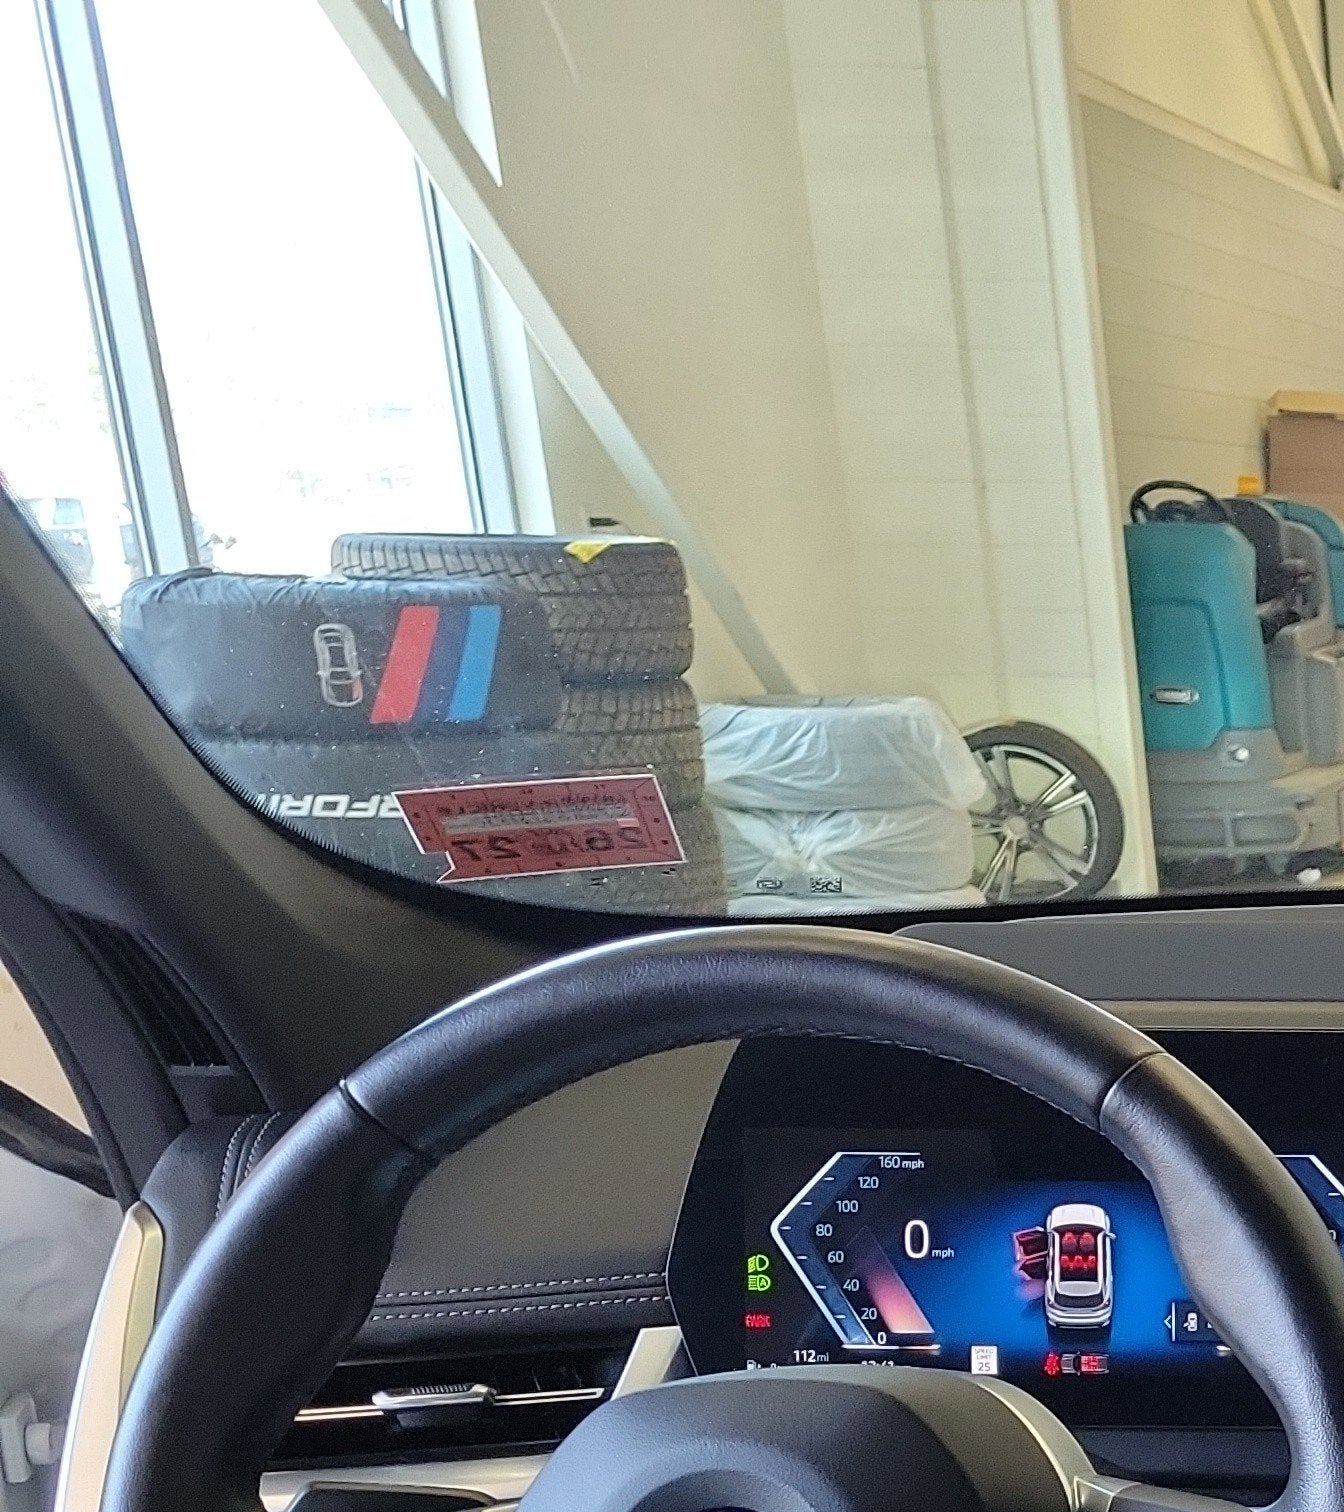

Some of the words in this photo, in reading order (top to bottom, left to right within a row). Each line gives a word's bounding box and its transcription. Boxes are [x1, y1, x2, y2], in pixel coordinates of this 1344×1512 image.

[878, 1156, 900, 1169] 160
[902, 1158, 924, 1170] mph
[858, 1176, 879, 1189] 120
[836, 1201, 858, 1213] 100
[815, 1224, 833, 1237] 80
[904, 1220, 930, 1259] 0
[932, 1247, 954, 1259] mph
[827, 1251, 844, 1263] 60
[843, 1279, 860, 1292] 40
[861, 1308, 877, 1320] 20
[877, 1332, 887, 1345] 0
[978, 1362, 991, 1371] 25
